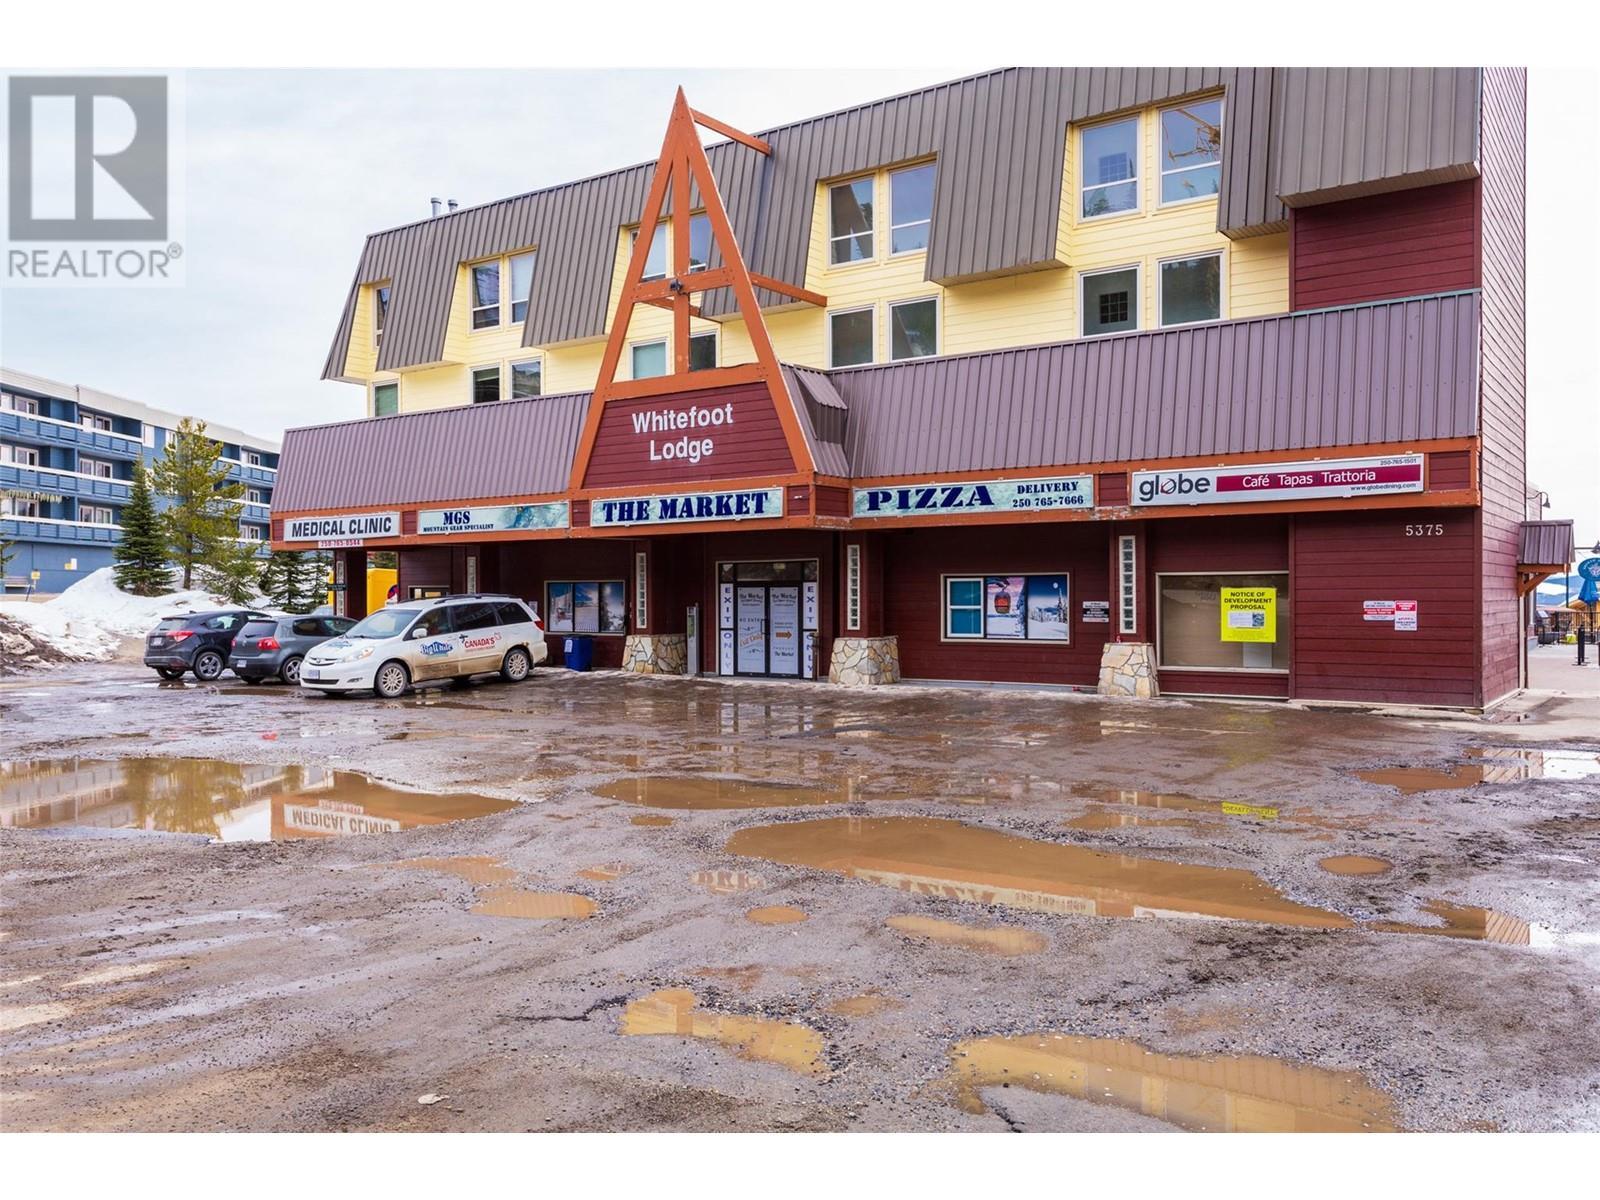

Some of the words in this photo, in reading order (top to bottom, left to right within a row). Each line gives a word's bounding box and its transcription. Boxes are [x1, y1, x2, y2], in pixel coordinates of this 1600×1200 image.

[632, 403, 734, 434] Whitefoot
[649, 436, 714, 463] Lodge
[1138, 473, 1211, 502] globe
[1242, 475, 1270, 489] Café
[1277, 474, 1313, 489] Tapas
[1321, 469, 1376, 484] Trattoria
[1350, 483, 1417, 491] www.globedining.com
[866, 485, 995, 511] PIZZA
[1016, 481, 1079, 495] DELIVERY
[1012, 498, 1031, 509] 250
[1034, 495, 1085, 508] 765-7666
[602, 500, 650, 523] THE
[658, 491, 769, 520] MARKET
[291, 520, 345, 538] MEDICAL
[348, 516, 392, 535] CLINIC
[443, 510, 471, 526] MGS
[463, 523, 494, 531] SPECIALIST
[1405, 524, 1444, 536] 5375
[464, 637, 496, 649] CANADA'S
